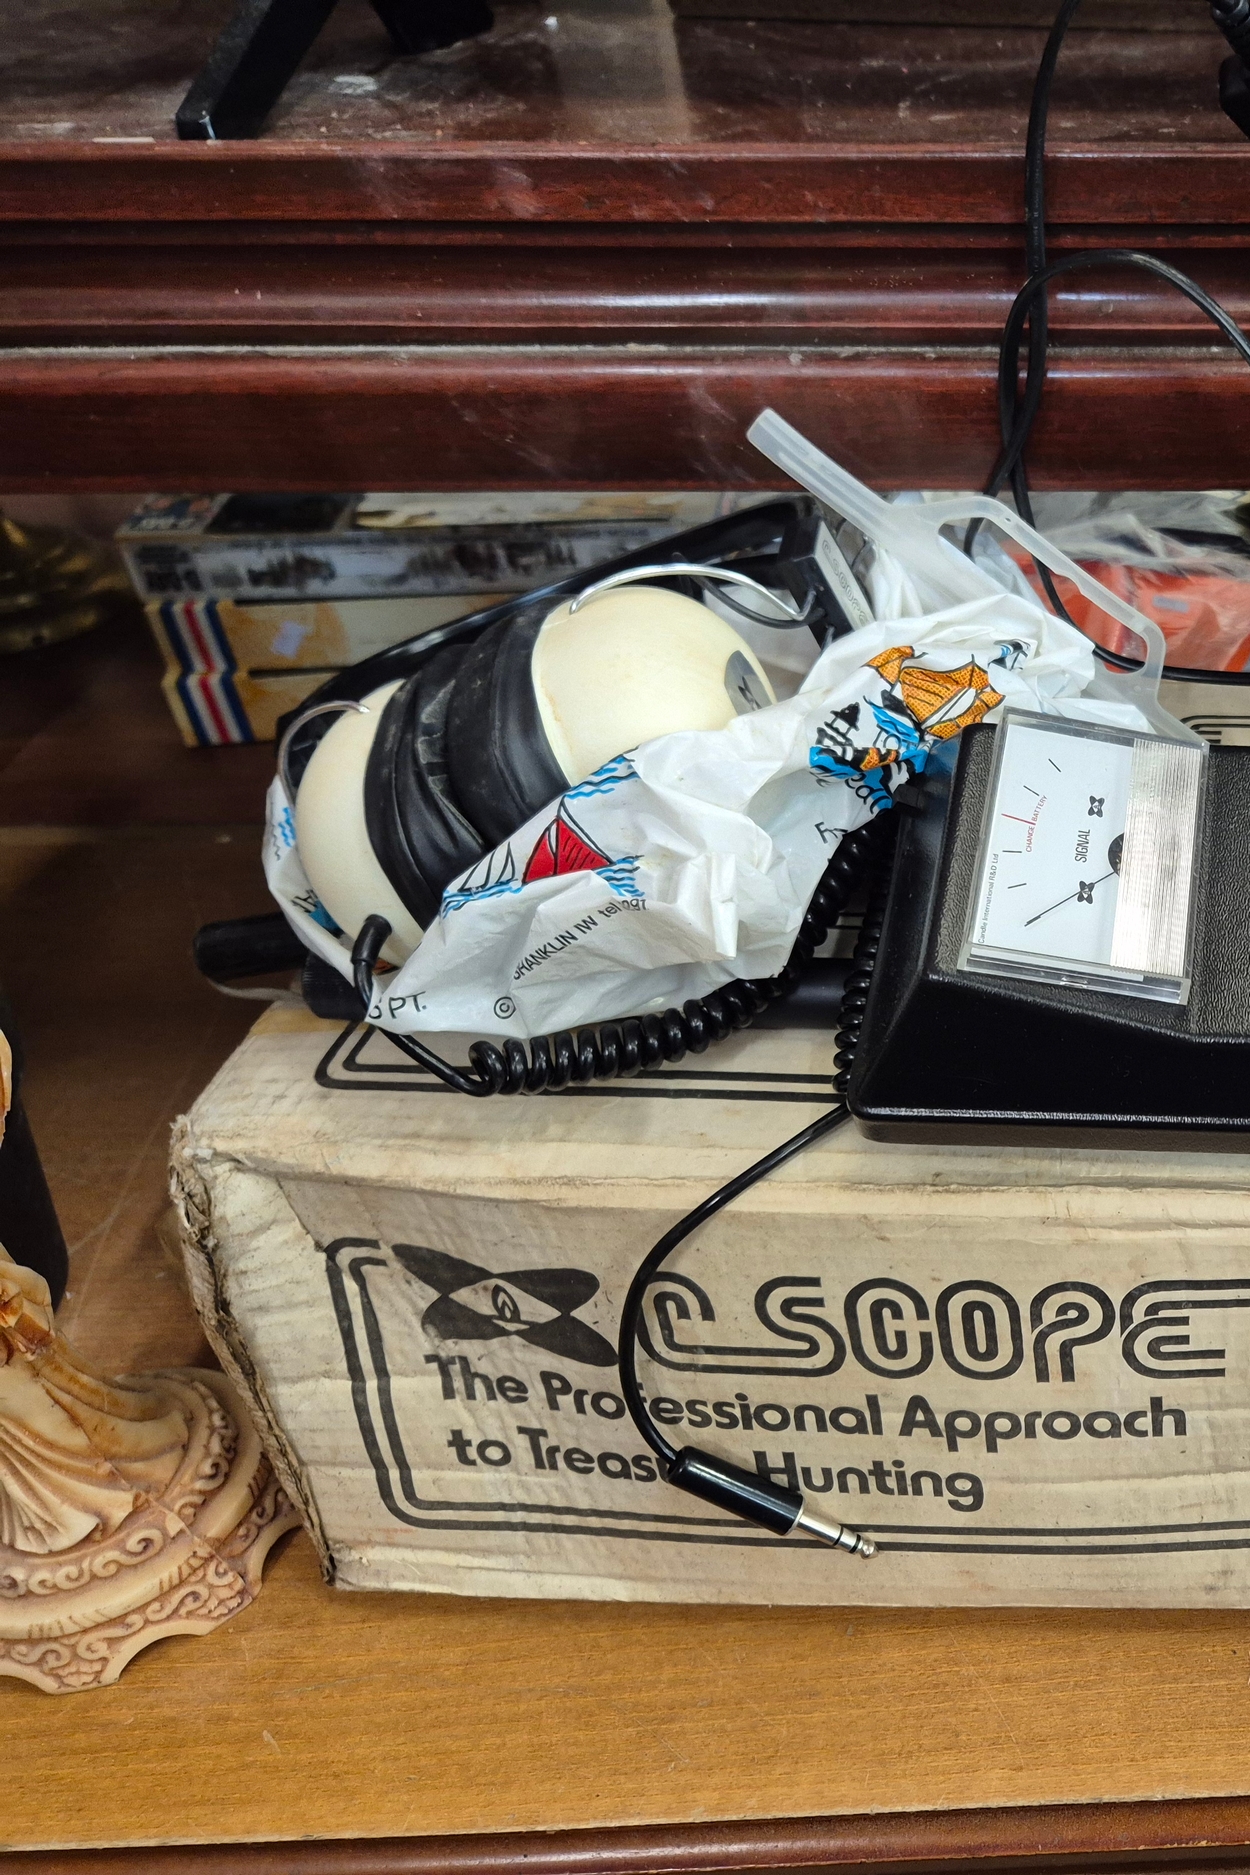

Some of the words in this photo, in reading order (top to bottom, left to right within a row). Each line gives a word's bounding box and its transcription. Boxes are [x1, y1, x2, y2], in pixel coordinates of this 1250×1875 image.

[1025, 825, 1035, 853] CHANGE
[1031, 795, 1048, 822] BATTERY
[1075, 829, 1091, 863] SIGNAL
[982, 881, 995, 921] International
[424, 1354, 529, 1404] The
[899, 1395, 1187, 1453] Approach
[447, 1429, 512, 1467] to
[516, 1425, 674, 1483] Treas
[753, 1451, 984, 1513] Hunting
